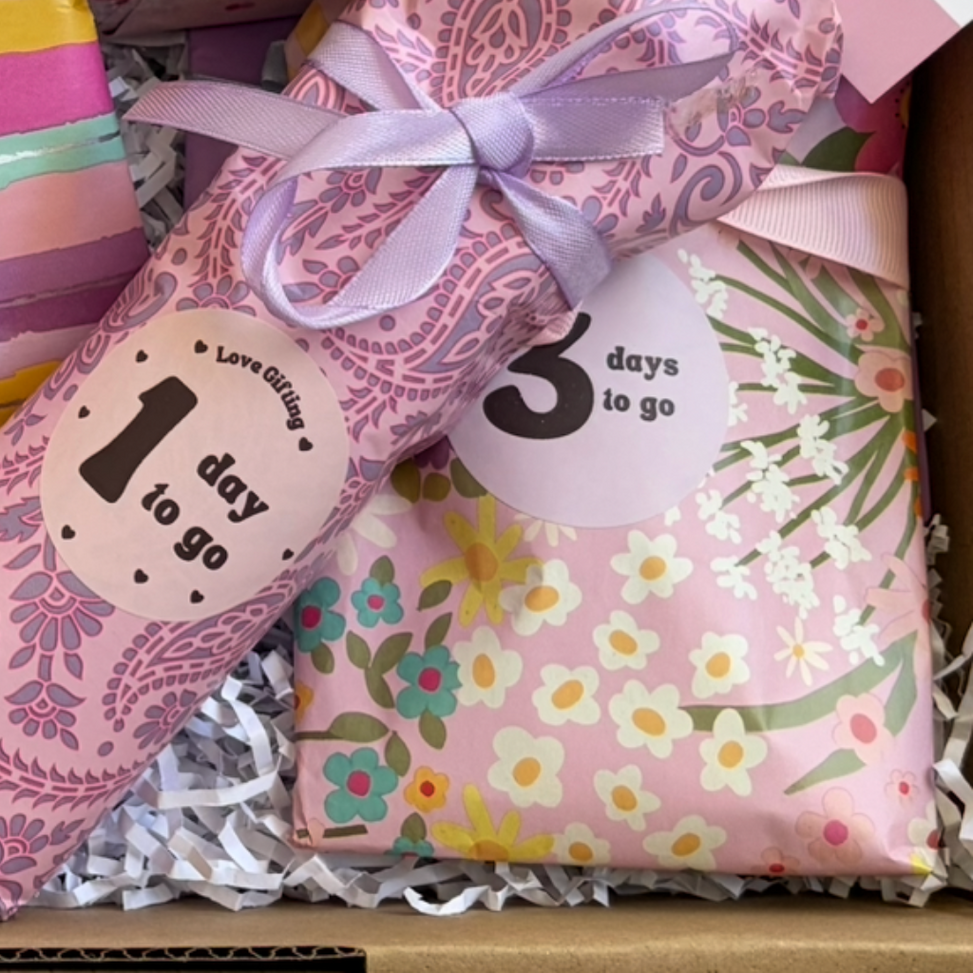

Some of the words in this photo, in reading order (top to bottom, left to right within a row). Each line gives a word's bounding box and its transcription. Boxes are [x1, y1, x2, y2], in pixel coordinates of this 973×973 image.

[216, 346, 263, 374] Love
[263, 366, 305, 430] Gifting
[482, 312, 594, 439] 3
[606, 346, 679, 380] days
[603, 388, 630, 412] to
[640, 396, 675, 421] go
[79, 376, 198, 504] 1
[197, 452, 269, 523] day
[141, 483, 180, 525] to
[174, 526, 228, 570] go
